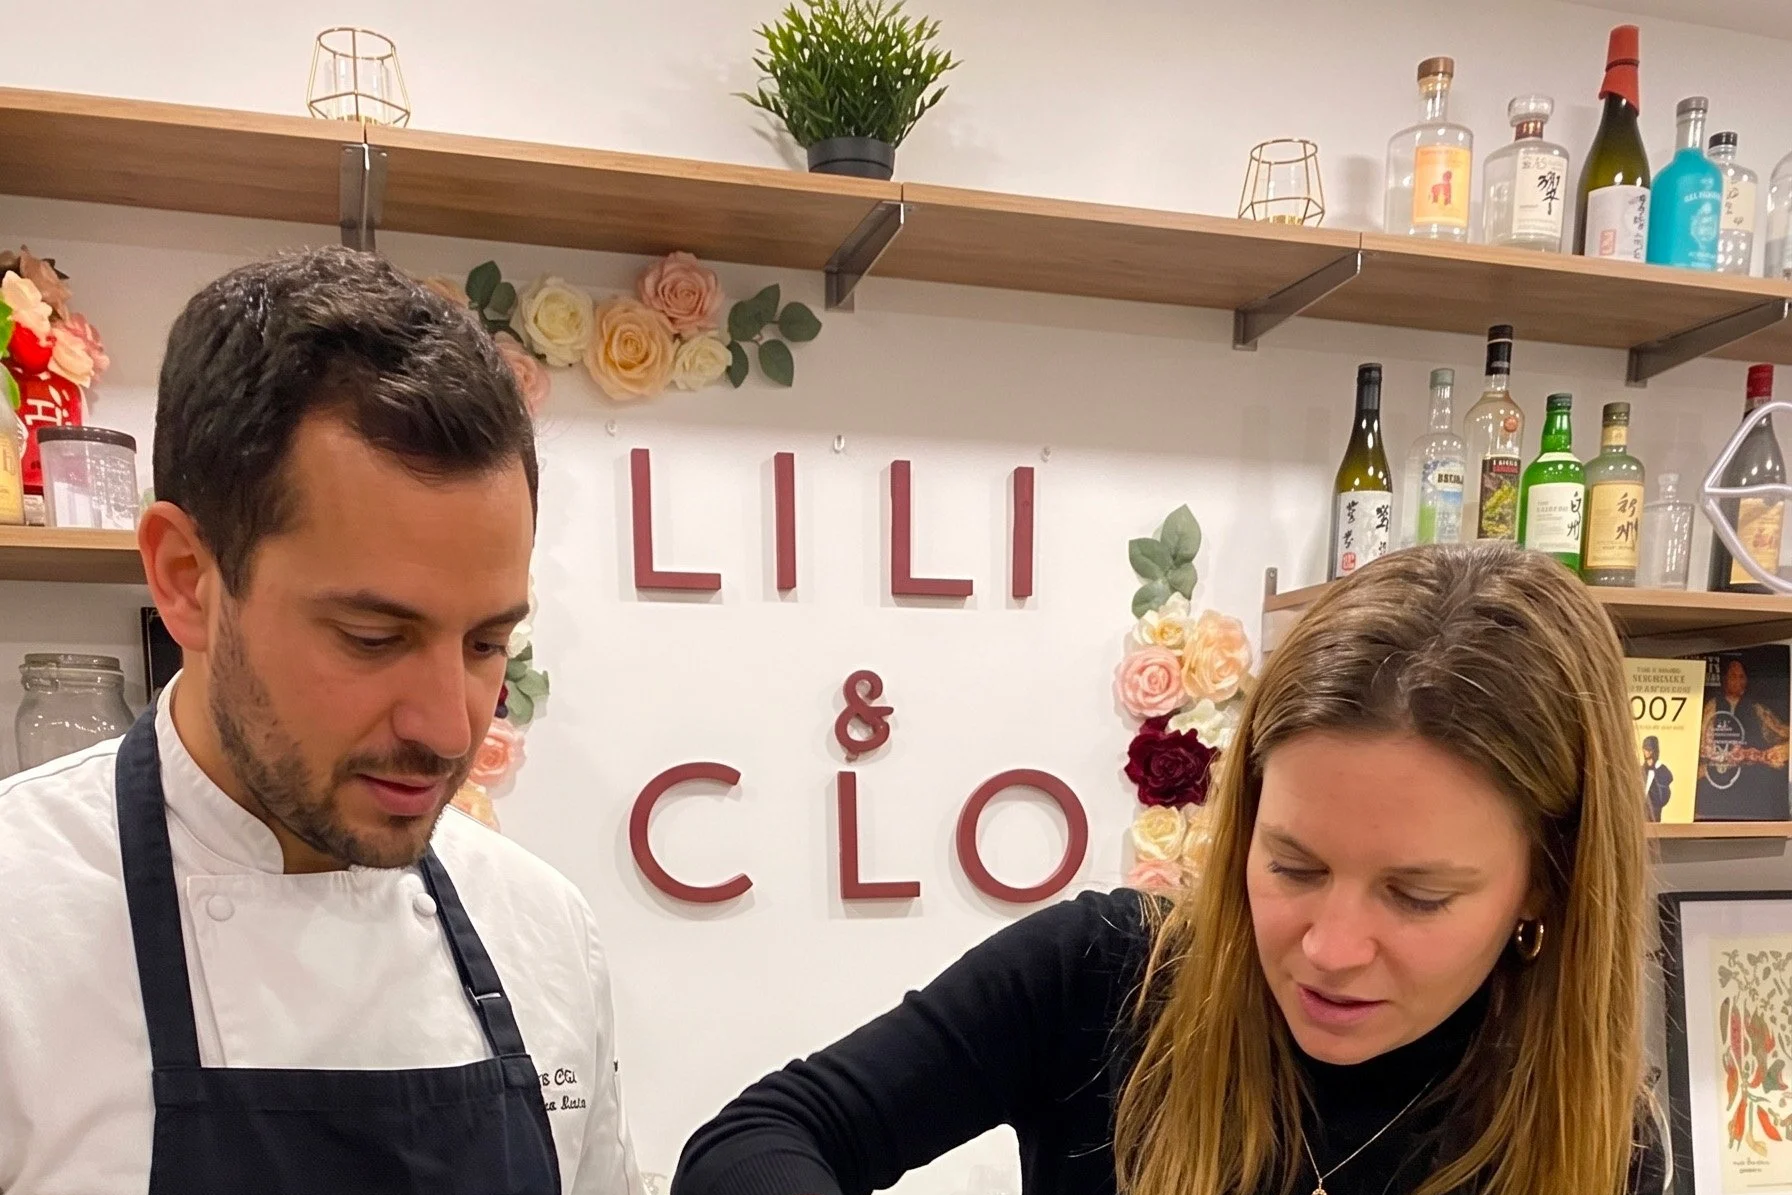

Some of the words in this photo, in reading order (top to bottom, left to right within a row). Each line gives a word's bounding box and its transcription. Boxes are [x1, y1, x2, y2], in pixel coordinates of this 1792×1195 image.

[630, 448, 1035, 597] LILI
[835, 670, 894, 754] &
[1631, 695, 1687, 722] 007
[629, 761, 1089, 904] CLO
